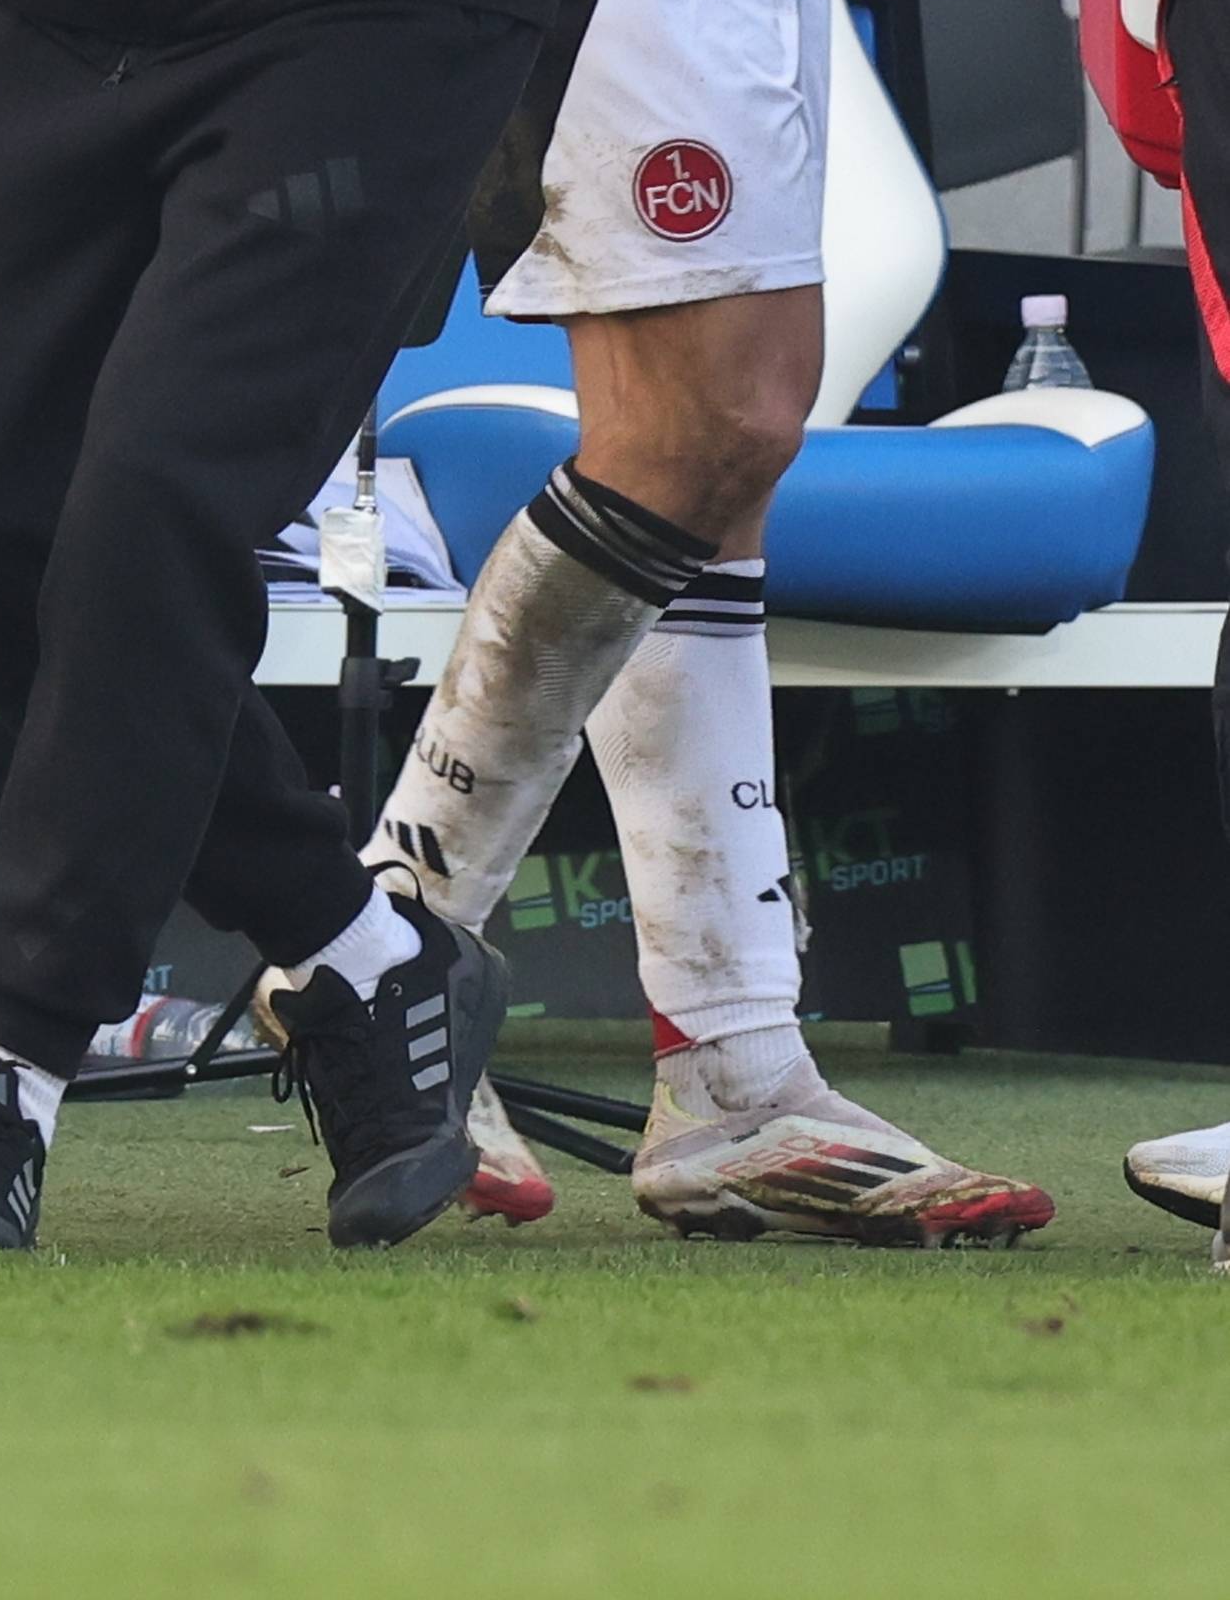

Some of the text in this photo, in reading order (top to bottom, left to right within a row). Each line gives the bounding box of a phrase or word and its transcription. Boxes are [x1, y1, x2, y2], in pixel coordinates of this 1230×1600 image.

[645, 177, 720, 219] FCN
[558, 851, 621, 918] K
[831, 853, 926, 892] SPORT
